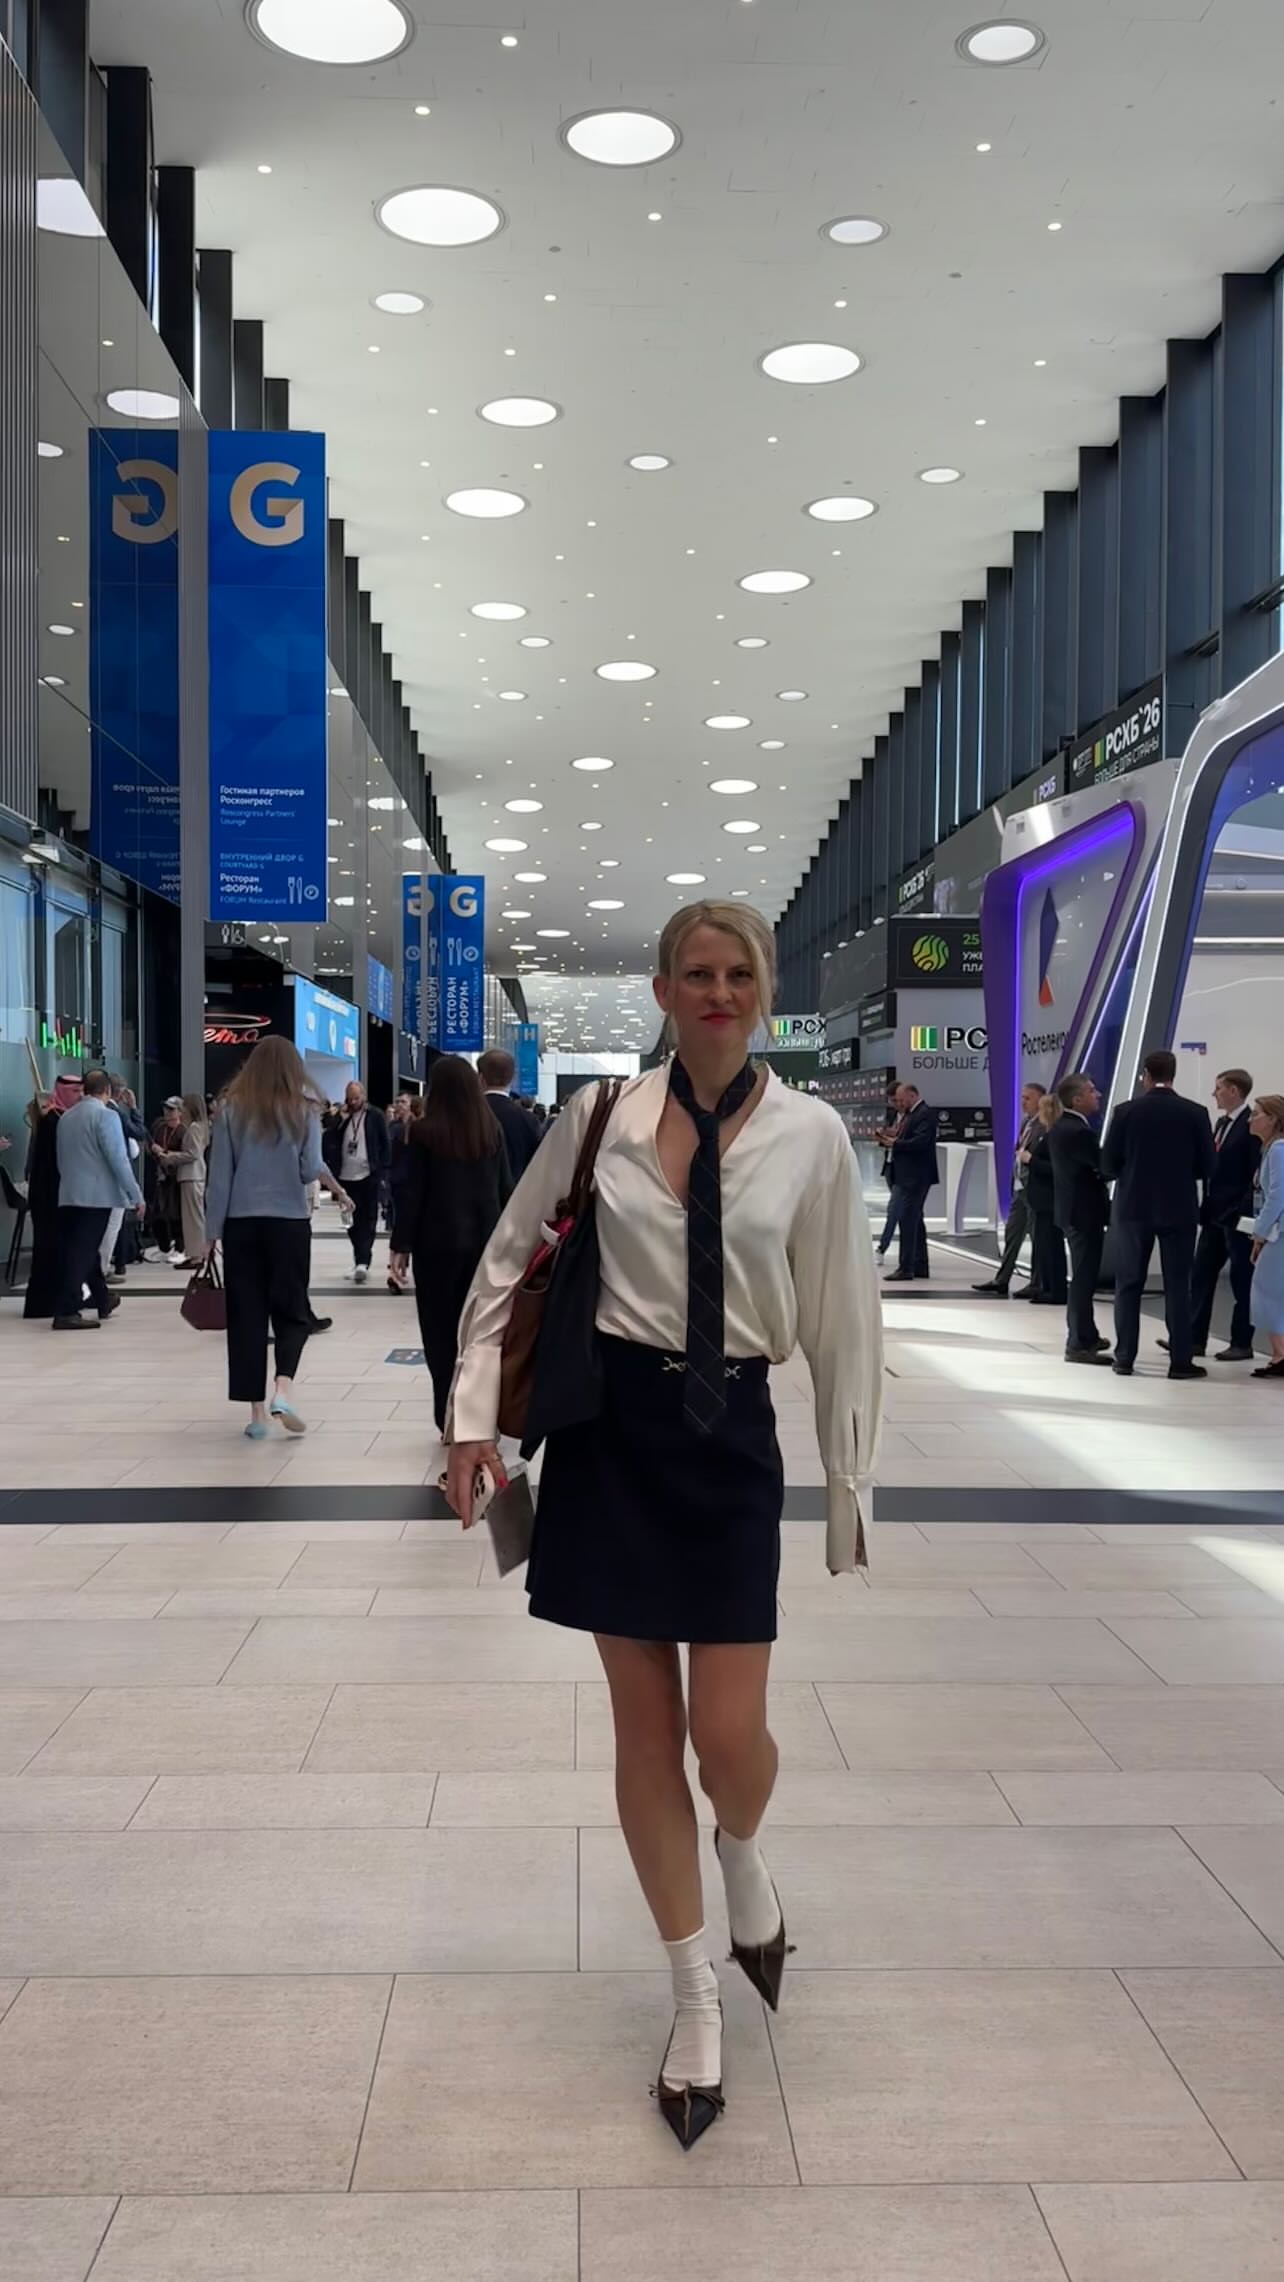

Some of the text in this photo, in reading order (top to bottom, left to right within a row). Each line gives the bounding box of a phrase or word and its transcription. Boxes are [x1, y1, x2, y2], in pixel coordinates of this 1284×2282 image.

[230, 462, 304, 546] G
[219, 785, 304, 797] Гостиная партнеров
[219, 795, 272, 806] Росконгресс
[219, 872, 260, 884] Ресторан
[219, 883, 263, 894] «ФОРУМ»
[450, 886, 477, 917] G
[447, 976, 457, 1034] РЕСТОРАН
[913, 1056, 979, 1069] БОЛЬШЕ
